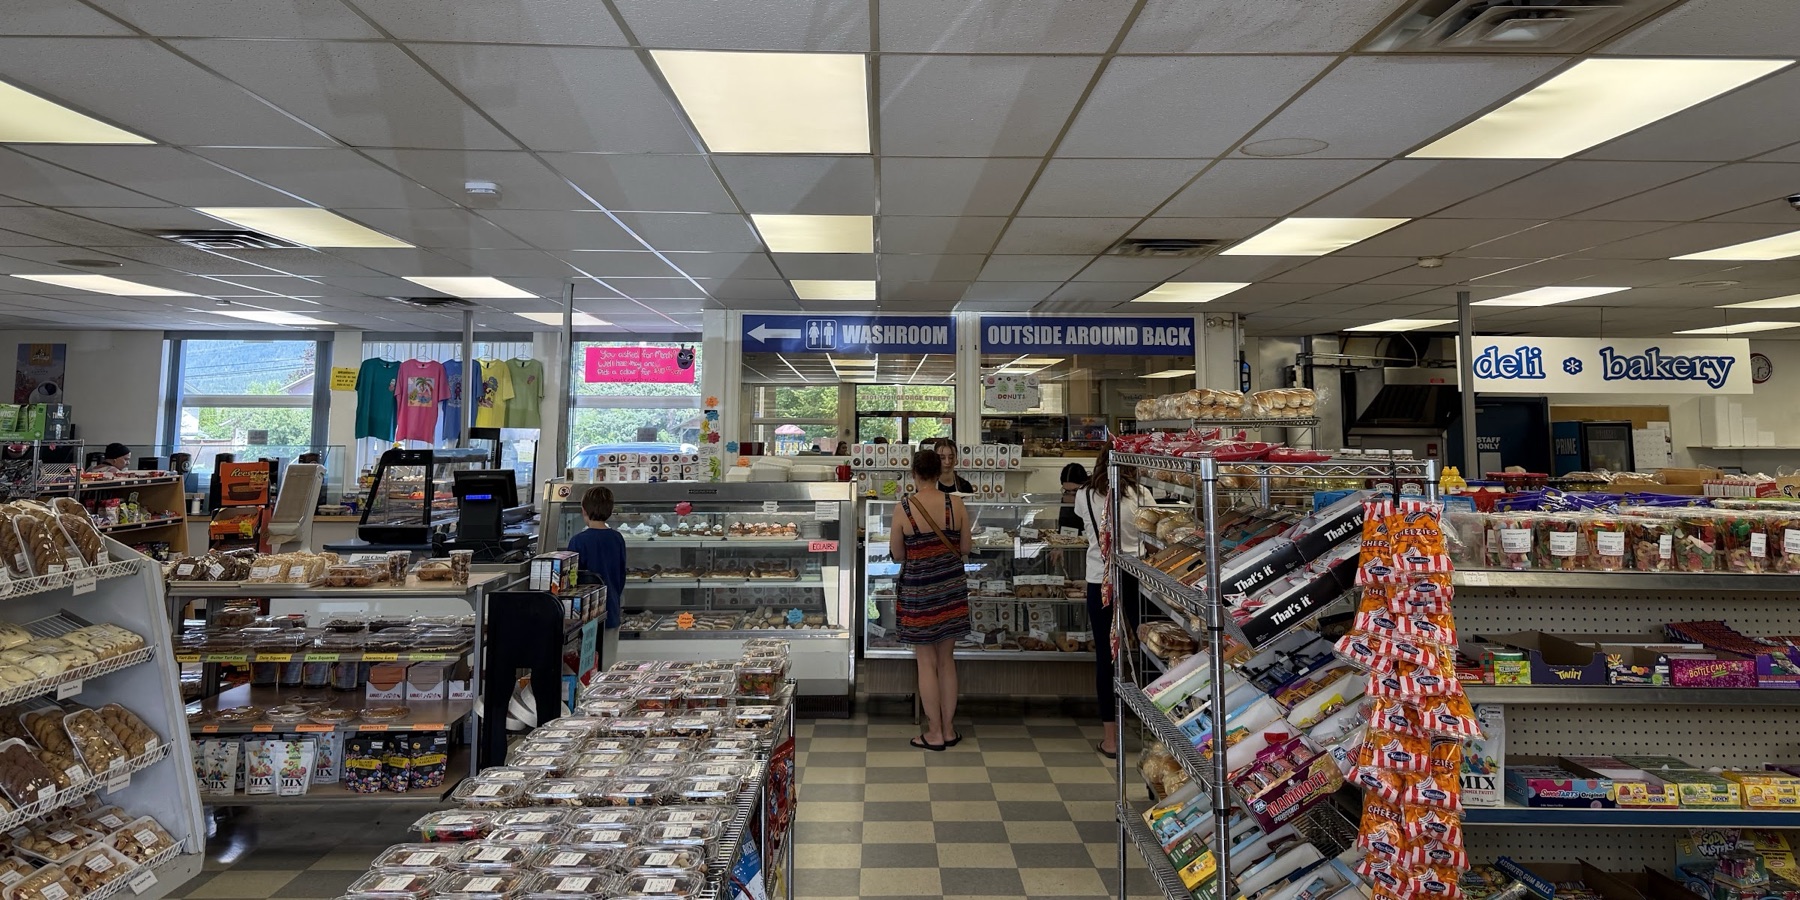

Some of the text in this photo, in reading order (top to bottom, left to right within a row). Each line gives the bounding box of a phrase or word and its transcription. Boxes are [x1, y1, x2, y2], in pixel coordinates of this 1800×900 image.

[842, 325, 948, 345] WASHROOM
[987, 325, 1191, 346] OUTSIDE AROUND BACK
[1473, 346, 1736, 389] deli bakery
[1556, 438, 1577, 454] PRIME
[1324, 521, 1354, 542] That's
[1394, 528, 1438, 540] CHEEZIES
[812, 542, 835, 550] ECLAIRS
[1234, 570, 1264, 593] That's
[1270, 601, 1302, 627] That's
[1555, 668, 1582, 681] Twirl
[1688, 662, 1727, 679] BOTTLE CAPS
[1265, 769, 1329, 818] MAMMOTH
[1702, 832, 1726, 845] SODA
[1698, 842, 1735, 856] BLASTERS
[1500, 858, 1552, 895] ASSORTED GUM BALLS
